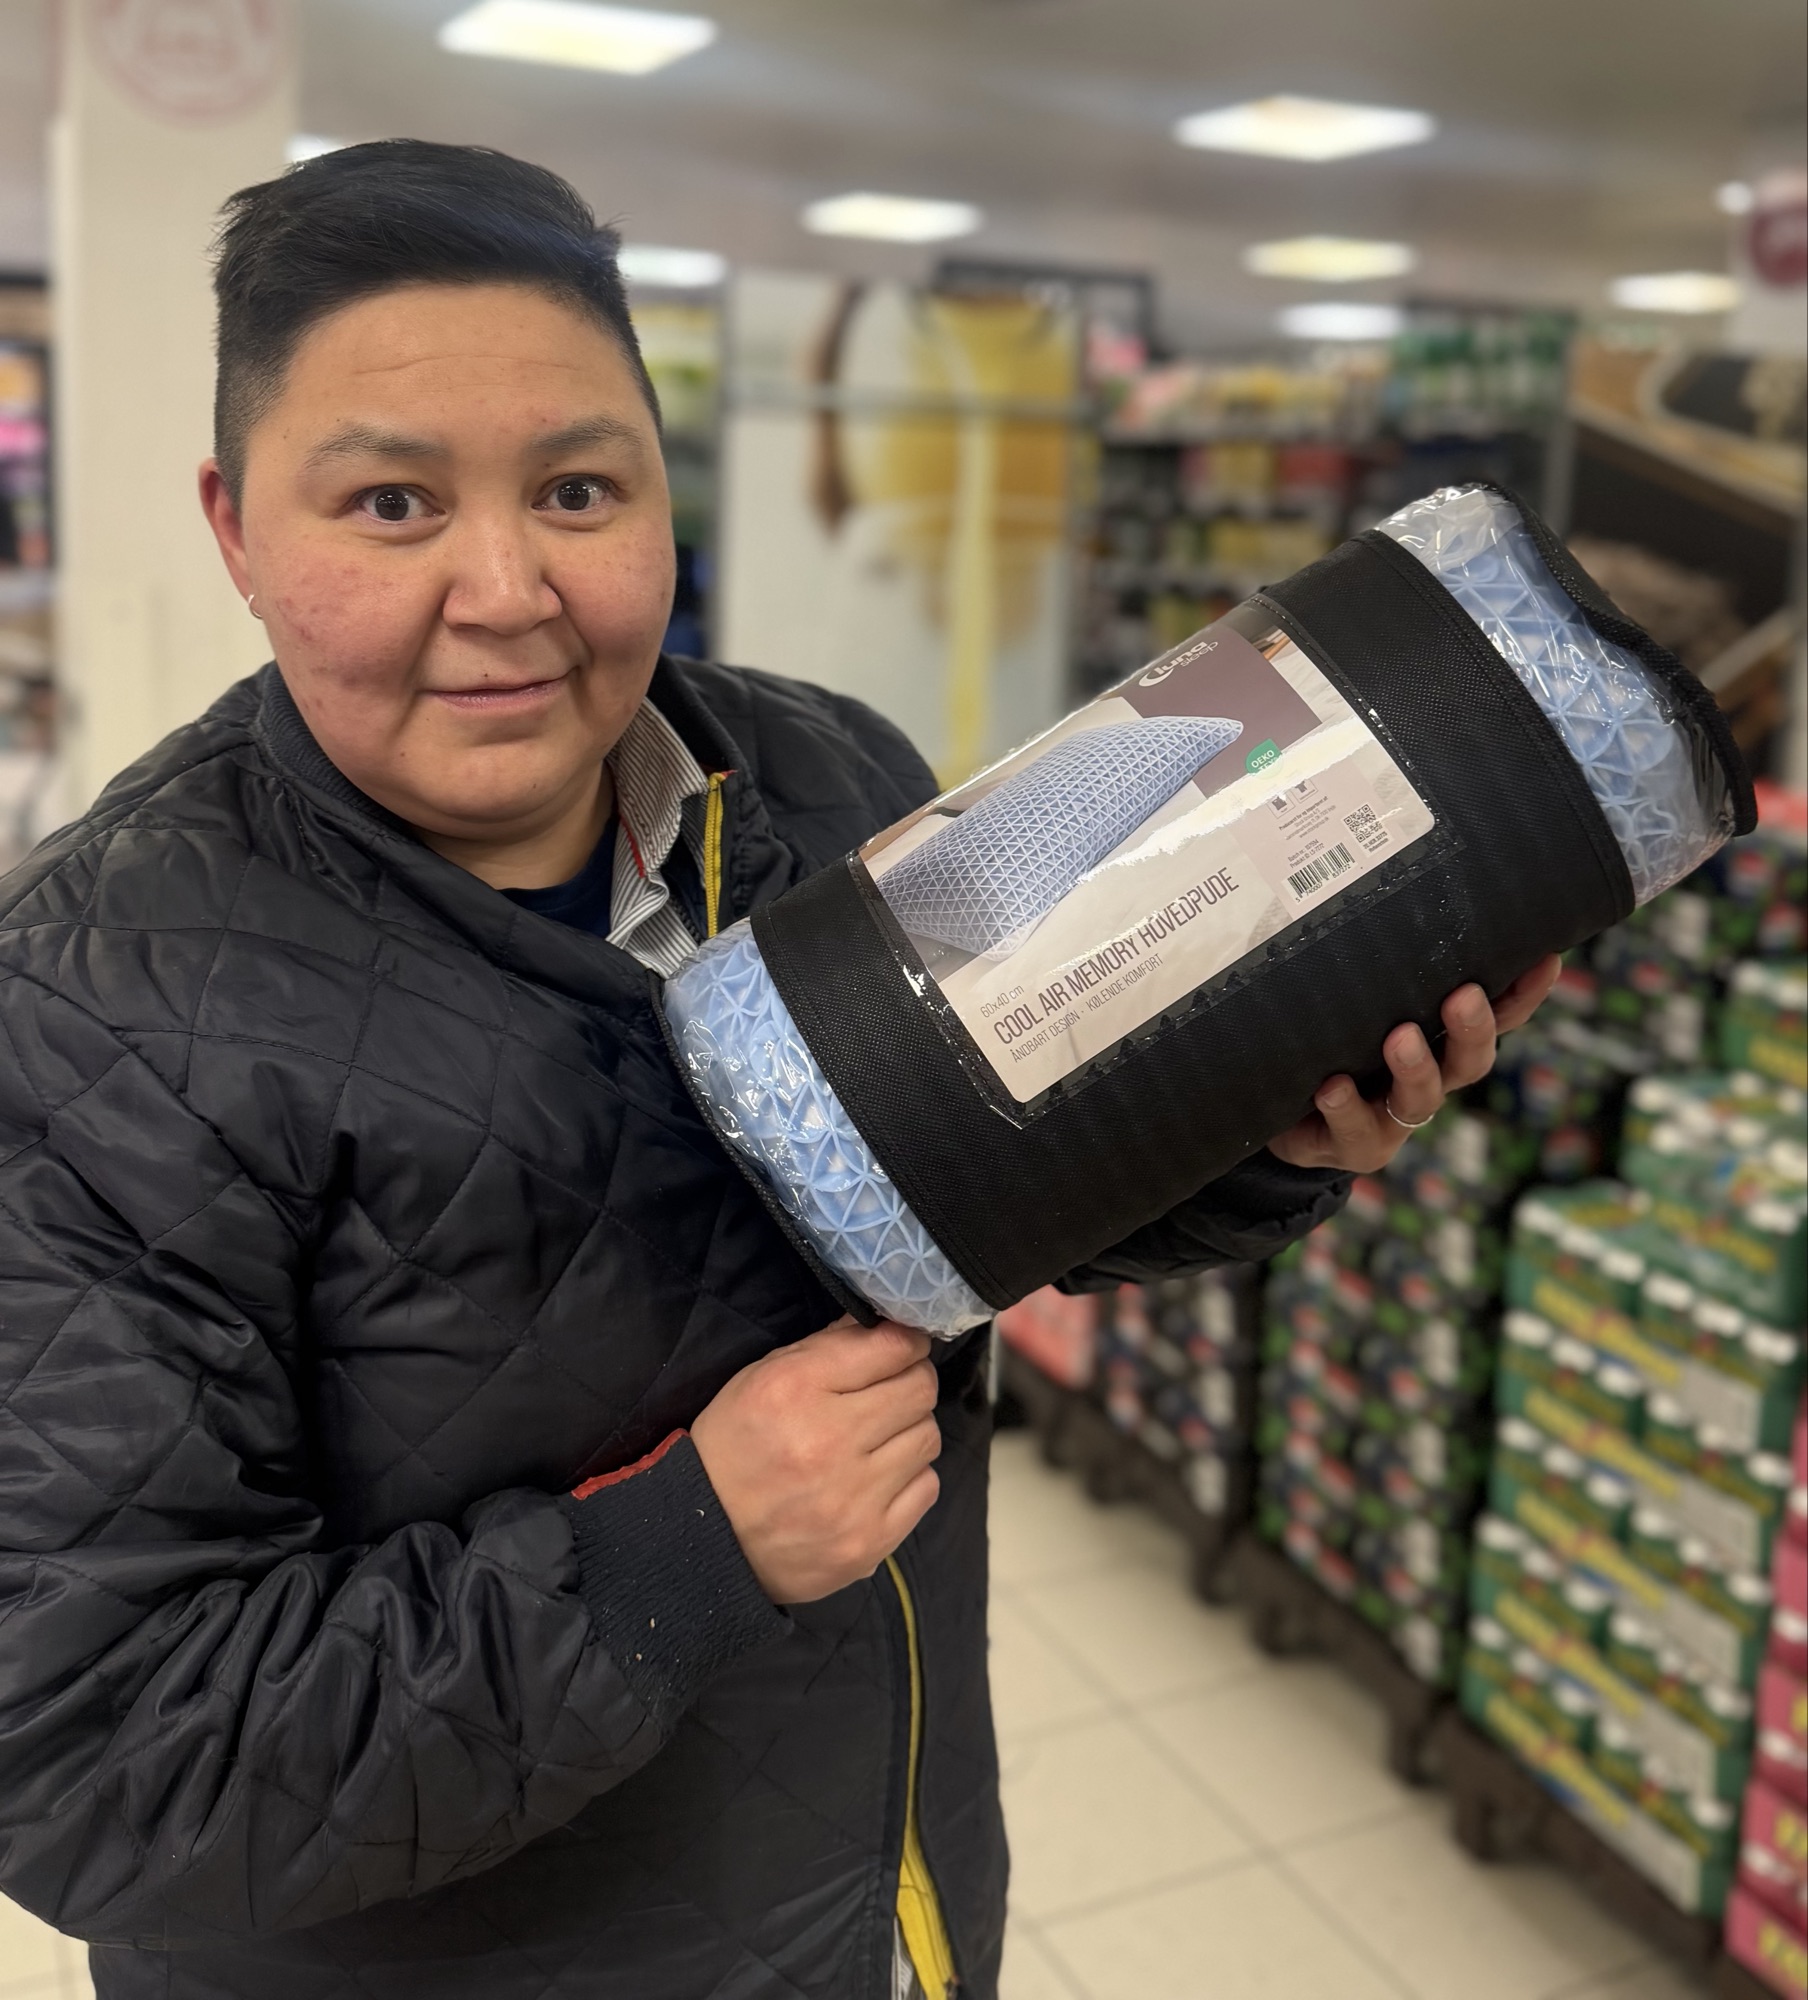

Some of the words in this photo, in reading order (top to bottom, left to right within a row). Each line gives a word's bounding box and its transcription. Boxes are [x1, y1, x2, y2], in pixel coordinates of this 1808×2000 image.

[1152, 641, 1208, 676] luna
[1180, 641, 1219, 667] sleep
[1251, 749, 1275, 768] OEKO
[1289, 855, 1305, 868] Produkt
[1305, 882, 1323, 896] 740007
[1332, 864, 1351, 878] 837272
[994, 1004, 1044, 1045] COOL
[1038, 982, 1072, 1016] AIR
[1064, 935, 1140, 996] MEMORY
[1137, 867, 1239, 947] HOVEDPUDE
[980, 993, 1009, 1018] 60x40
[1010, 985, 1025, 999] cm
[1010, 1030, 1051, 1063] ÅNDBART
[1049, 1010, 1080, 1037] DESIGN
[1086, 979, 1126, 1012] KØLENDE
[1122, 953, 1164, 986] KOMFORT
